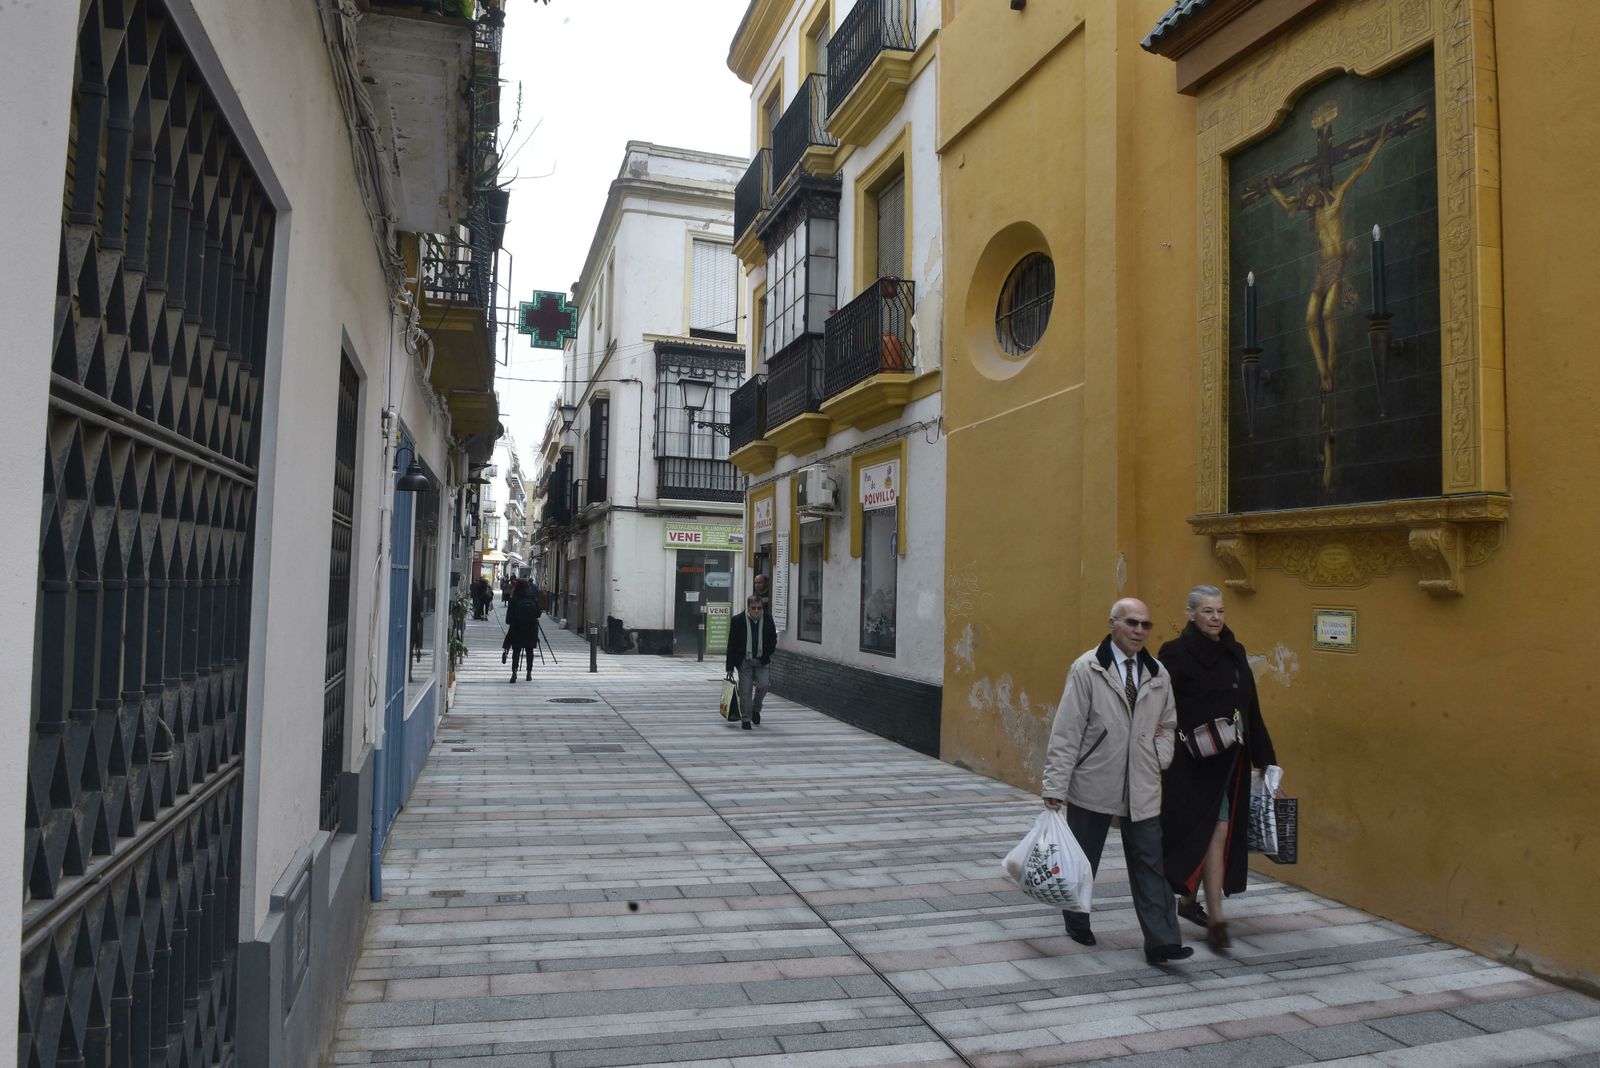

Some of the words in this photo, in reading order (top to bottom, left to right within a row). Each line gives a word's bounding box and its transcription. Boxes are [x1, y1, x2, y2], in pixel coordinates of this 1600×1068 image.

[864, 488, 895, 505] POLVILLO
[669, 532, 701, 542] VENE
[1287, 800, 1296, 862] EXPERIENCE
